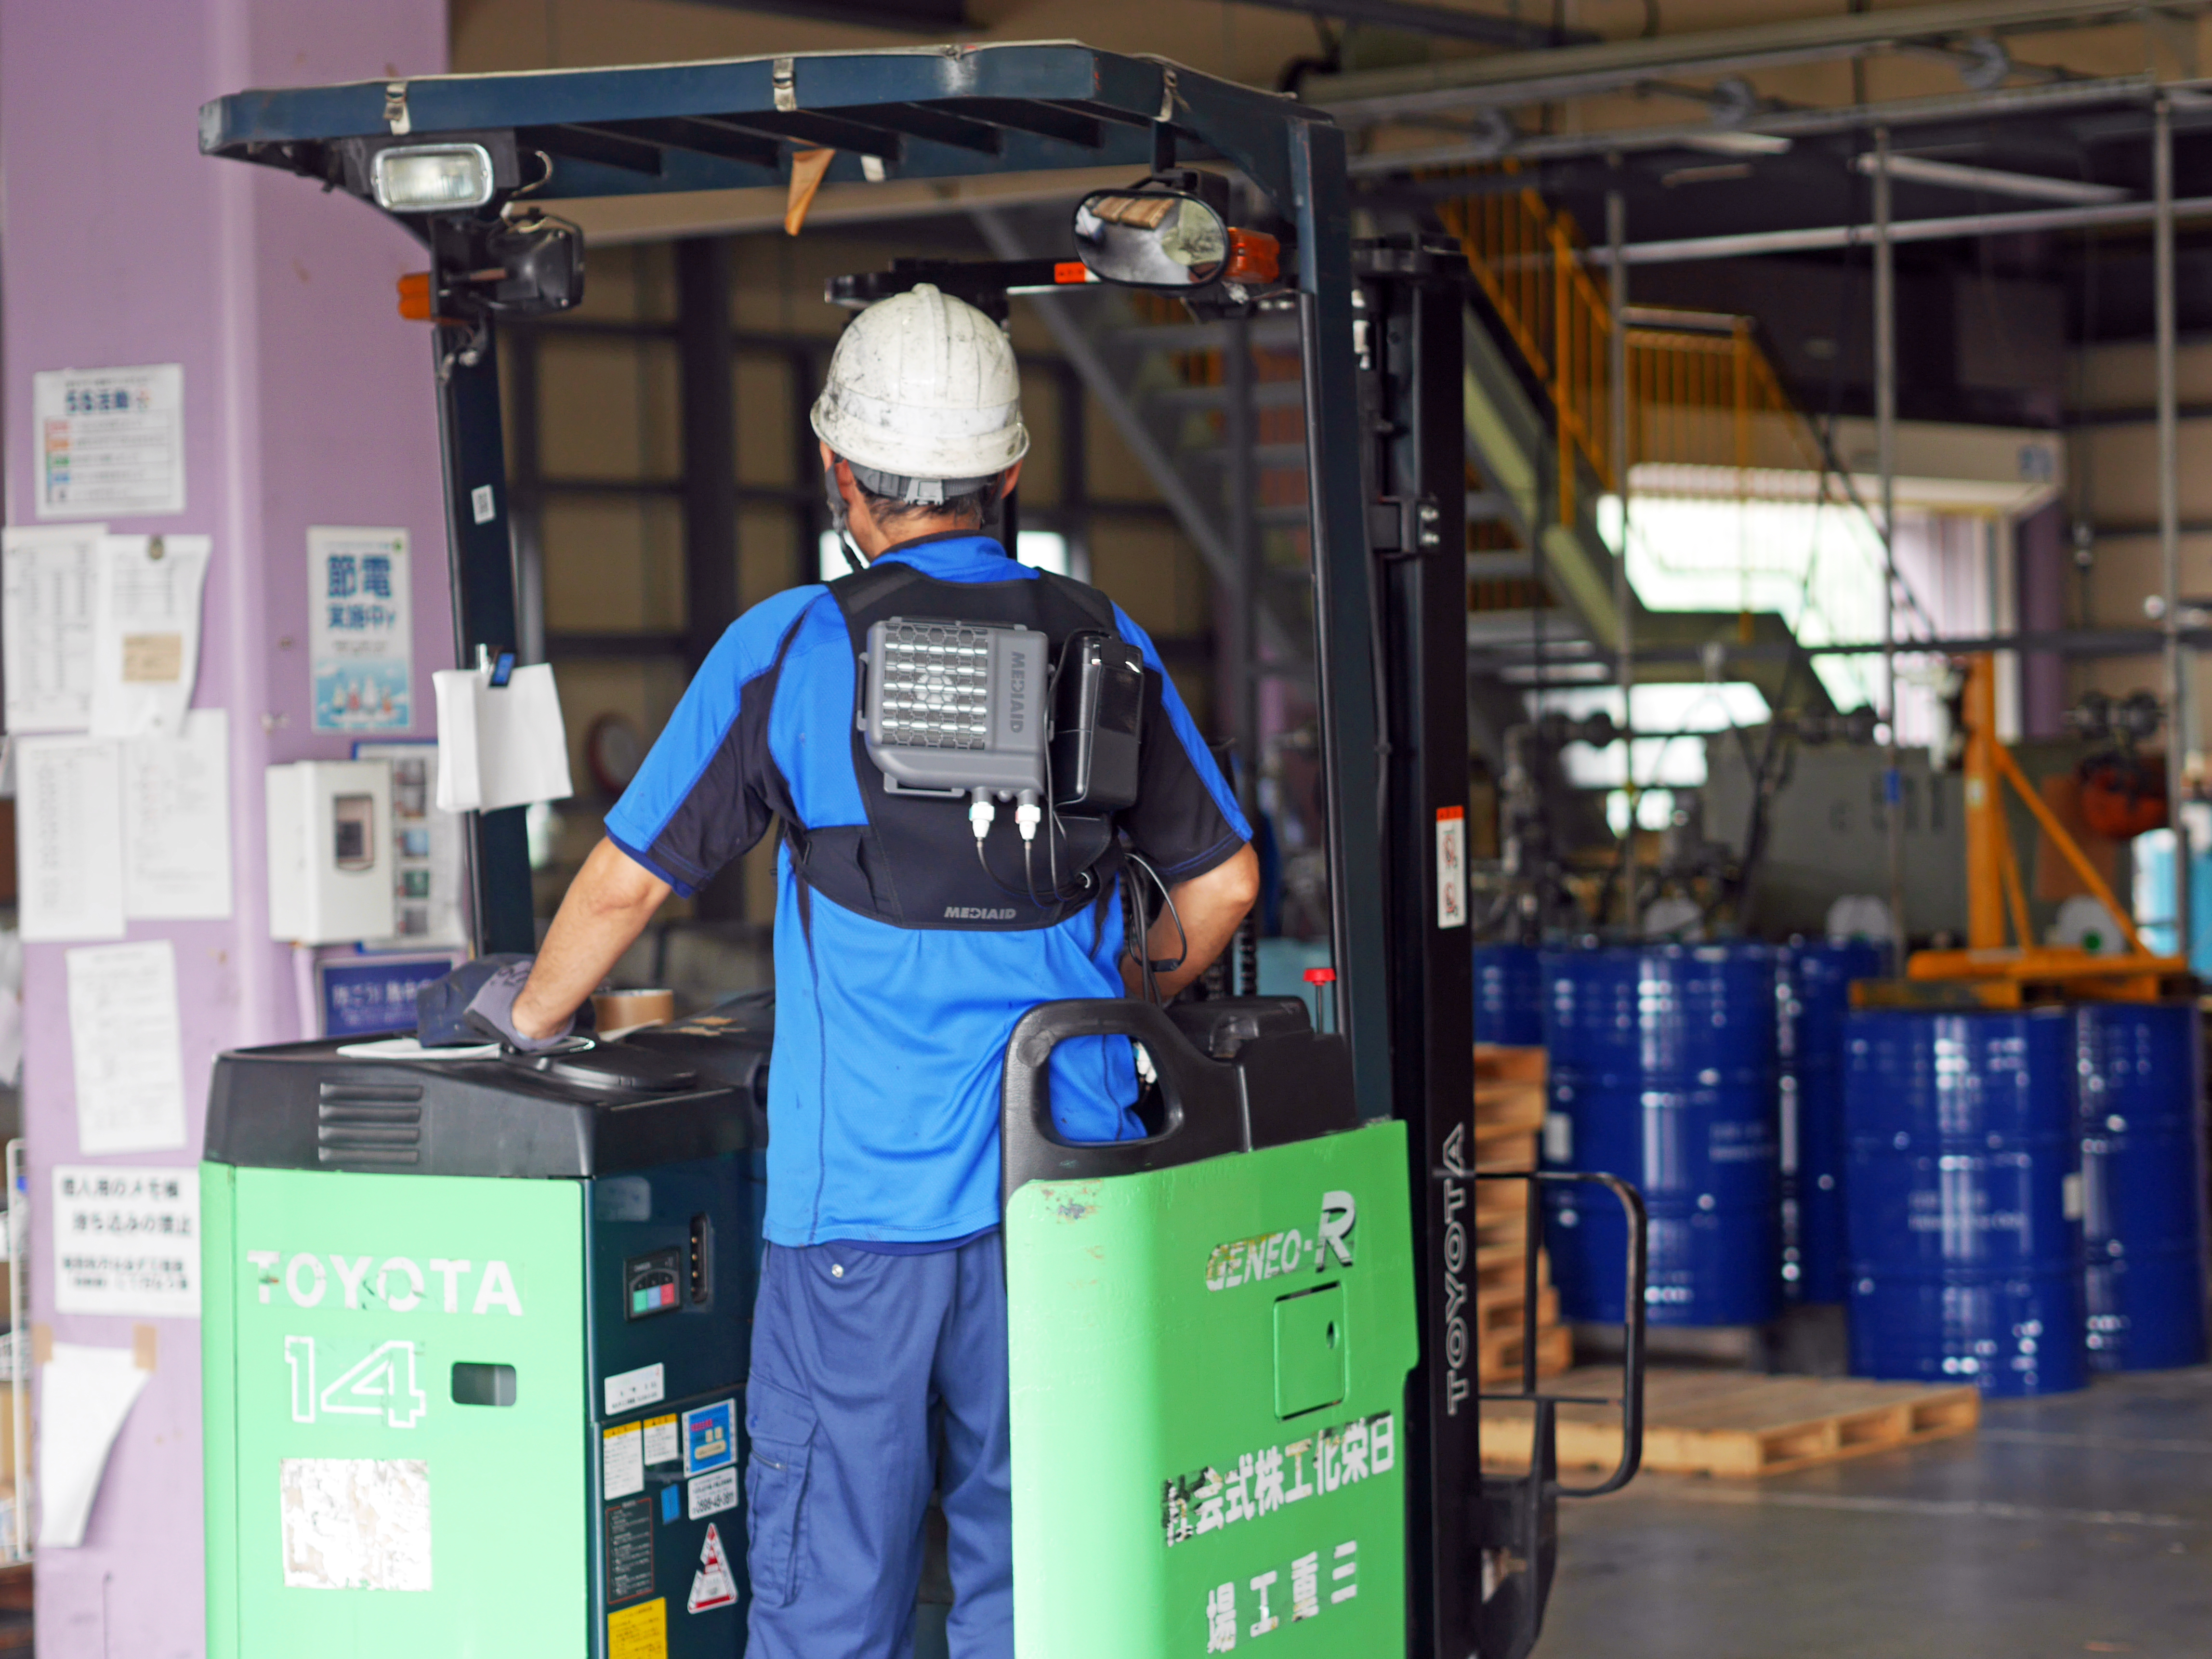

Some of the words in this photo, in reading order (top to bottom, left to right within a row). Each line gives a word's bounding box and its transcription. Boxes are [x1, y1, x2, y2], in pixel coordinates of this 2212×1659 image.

[329, 556, 391, 598] 節電
[1010, 651, 1025, 733] MEDIAID
[944, 907, 1016, 919] MEDIAID
[247, 1250, 522, 1316] TOYOTA
[1443, 1121, 1470, 1416] TOYOTA
[284, 1334, 426, 1429] 14
